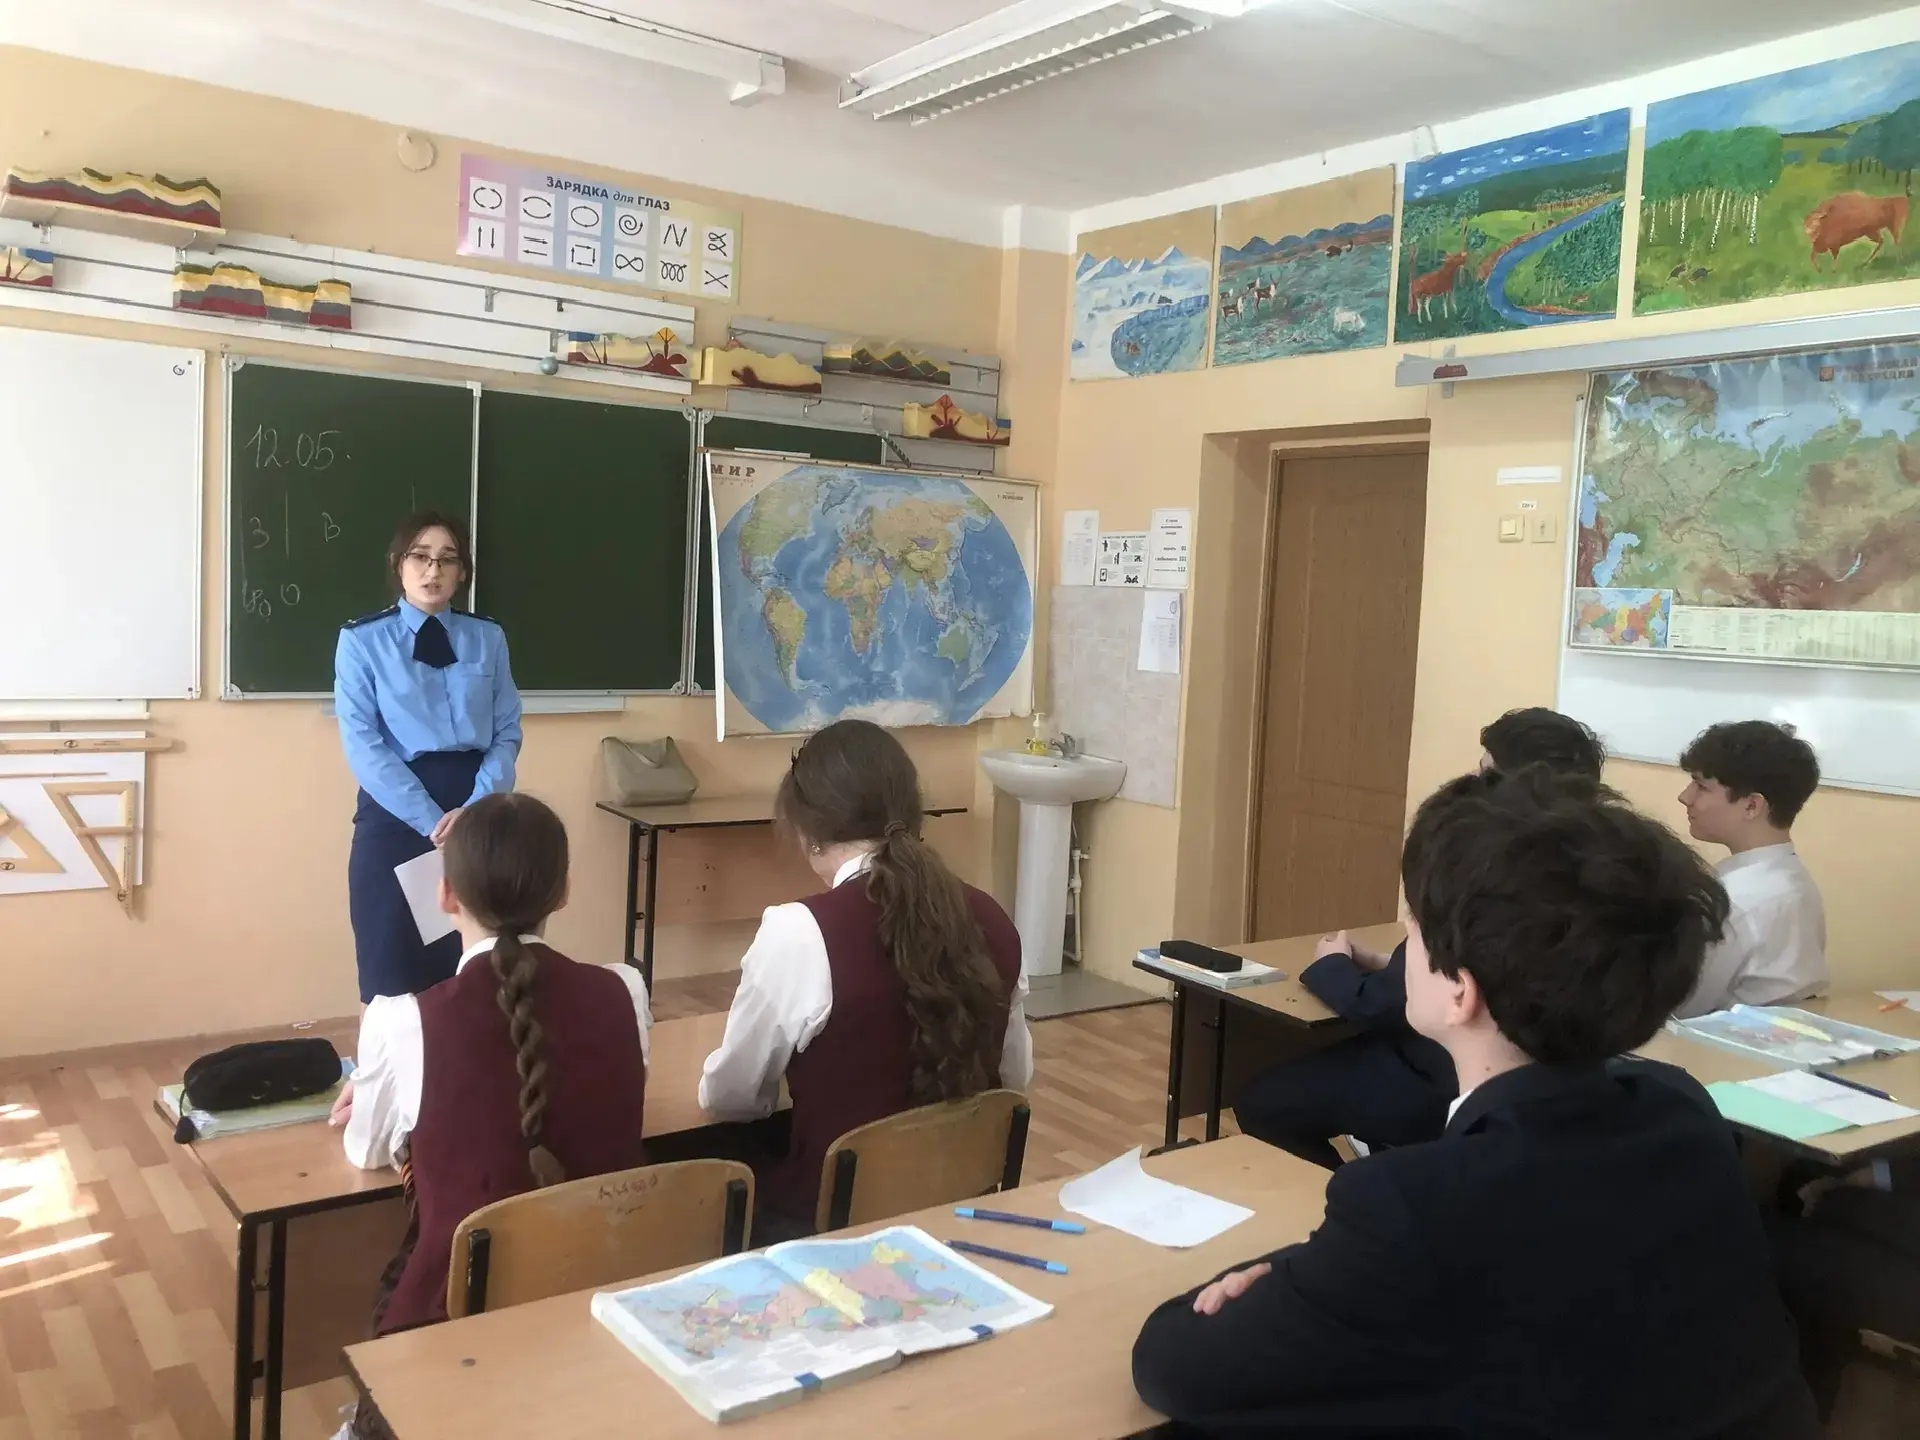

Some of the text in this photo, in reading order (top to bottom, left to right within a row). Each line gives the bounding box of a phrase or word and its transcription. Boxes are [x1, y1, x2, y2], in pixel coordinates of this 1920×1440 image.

[546, 176, 671, 211] ЗАРЯДКА для ГЛАЗ
[711, 463, 756, 477] МИР
